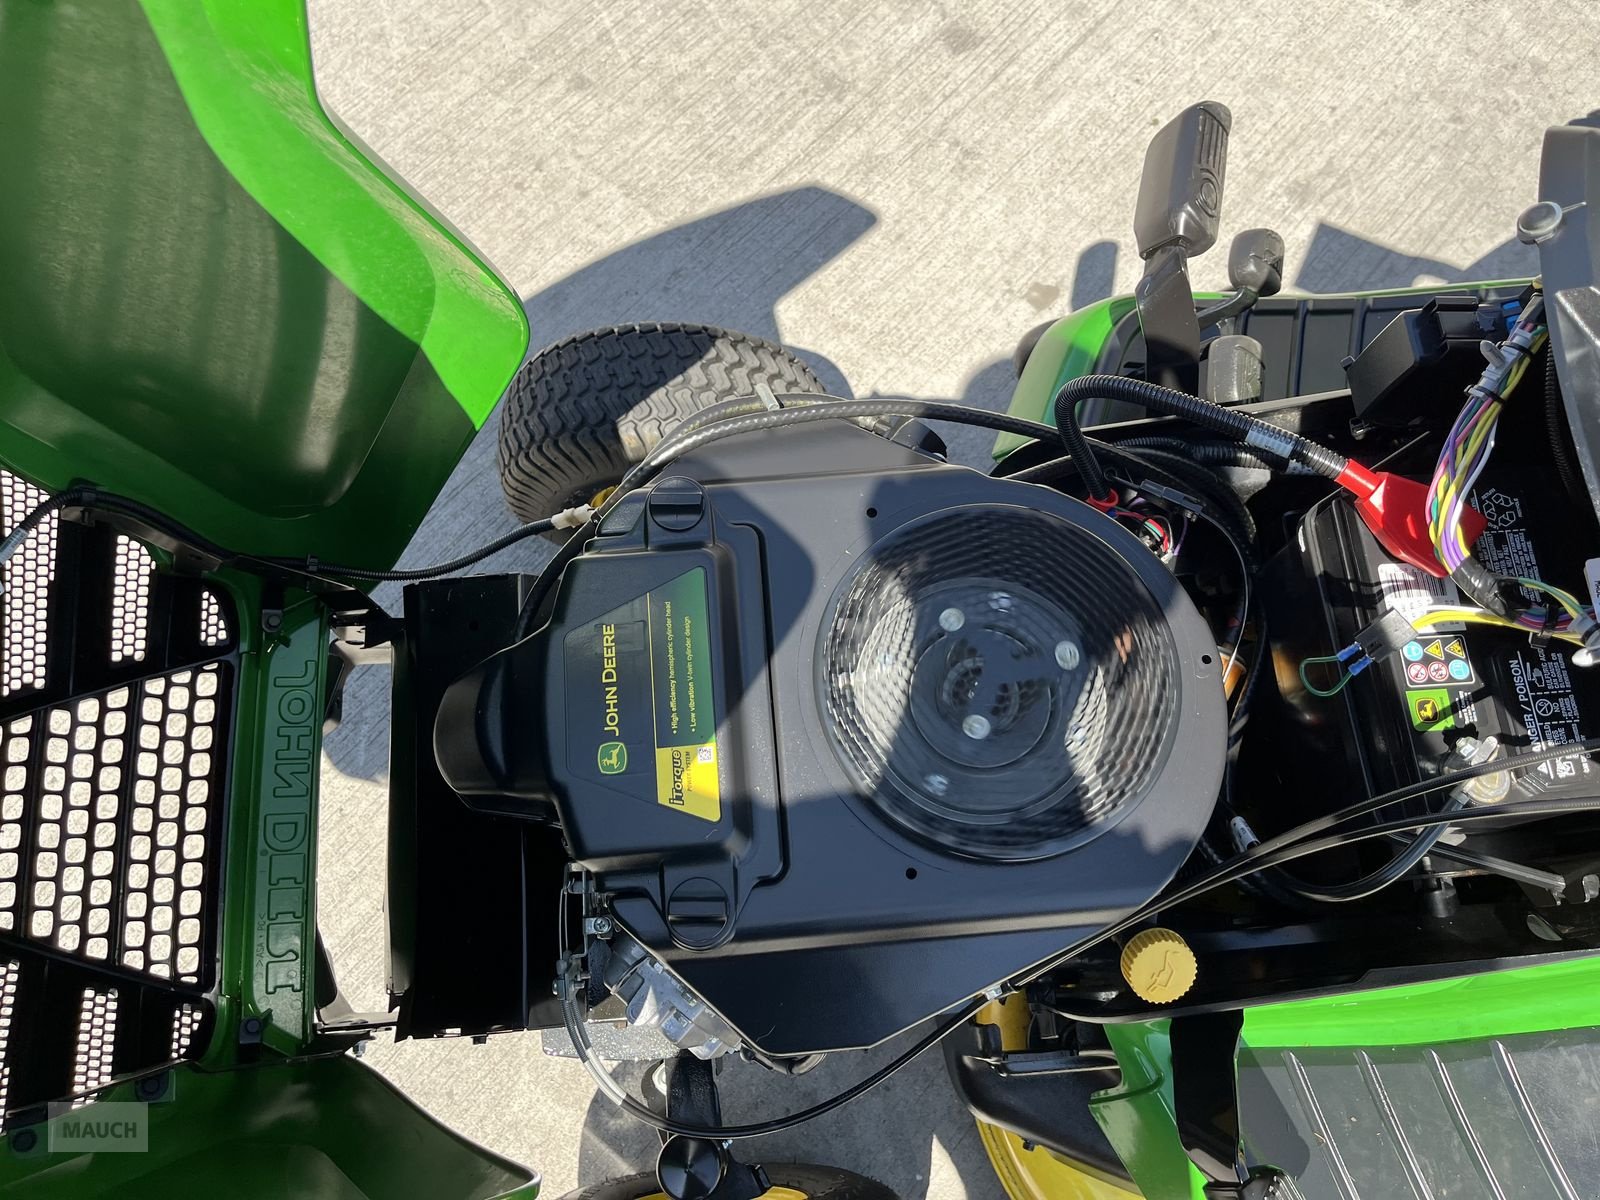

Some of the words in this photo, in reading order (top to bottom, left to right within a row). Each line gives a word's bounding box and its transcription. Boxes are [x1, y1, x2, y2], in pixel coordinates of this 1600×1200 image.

[666, 617, 674, 641] cylinder
[684, 616, 692, 637] design
[600, 624, 617, 683] DEERE
[667, 642, 676, 678] hemispheric
[685, 638, 693, 661] cylinder
[686, 662, 694, 681] V-twin
[1509, 659, 1528, 702] POISON
[1541, 662, 1554, 689] SULFURIC
[669, 679, 678, 711] efficiency
[687, 682, 696, 711] vibration
[1553, 702, 1560, 712] NO
[602, 687, 619, 737] JOHN
[671, 713, 679, 729] High
[1523, 714, 1542, 753] ANGER
[1552, 730, 1561, 745] EYES
[667, 749, 685, 806] iTorque
